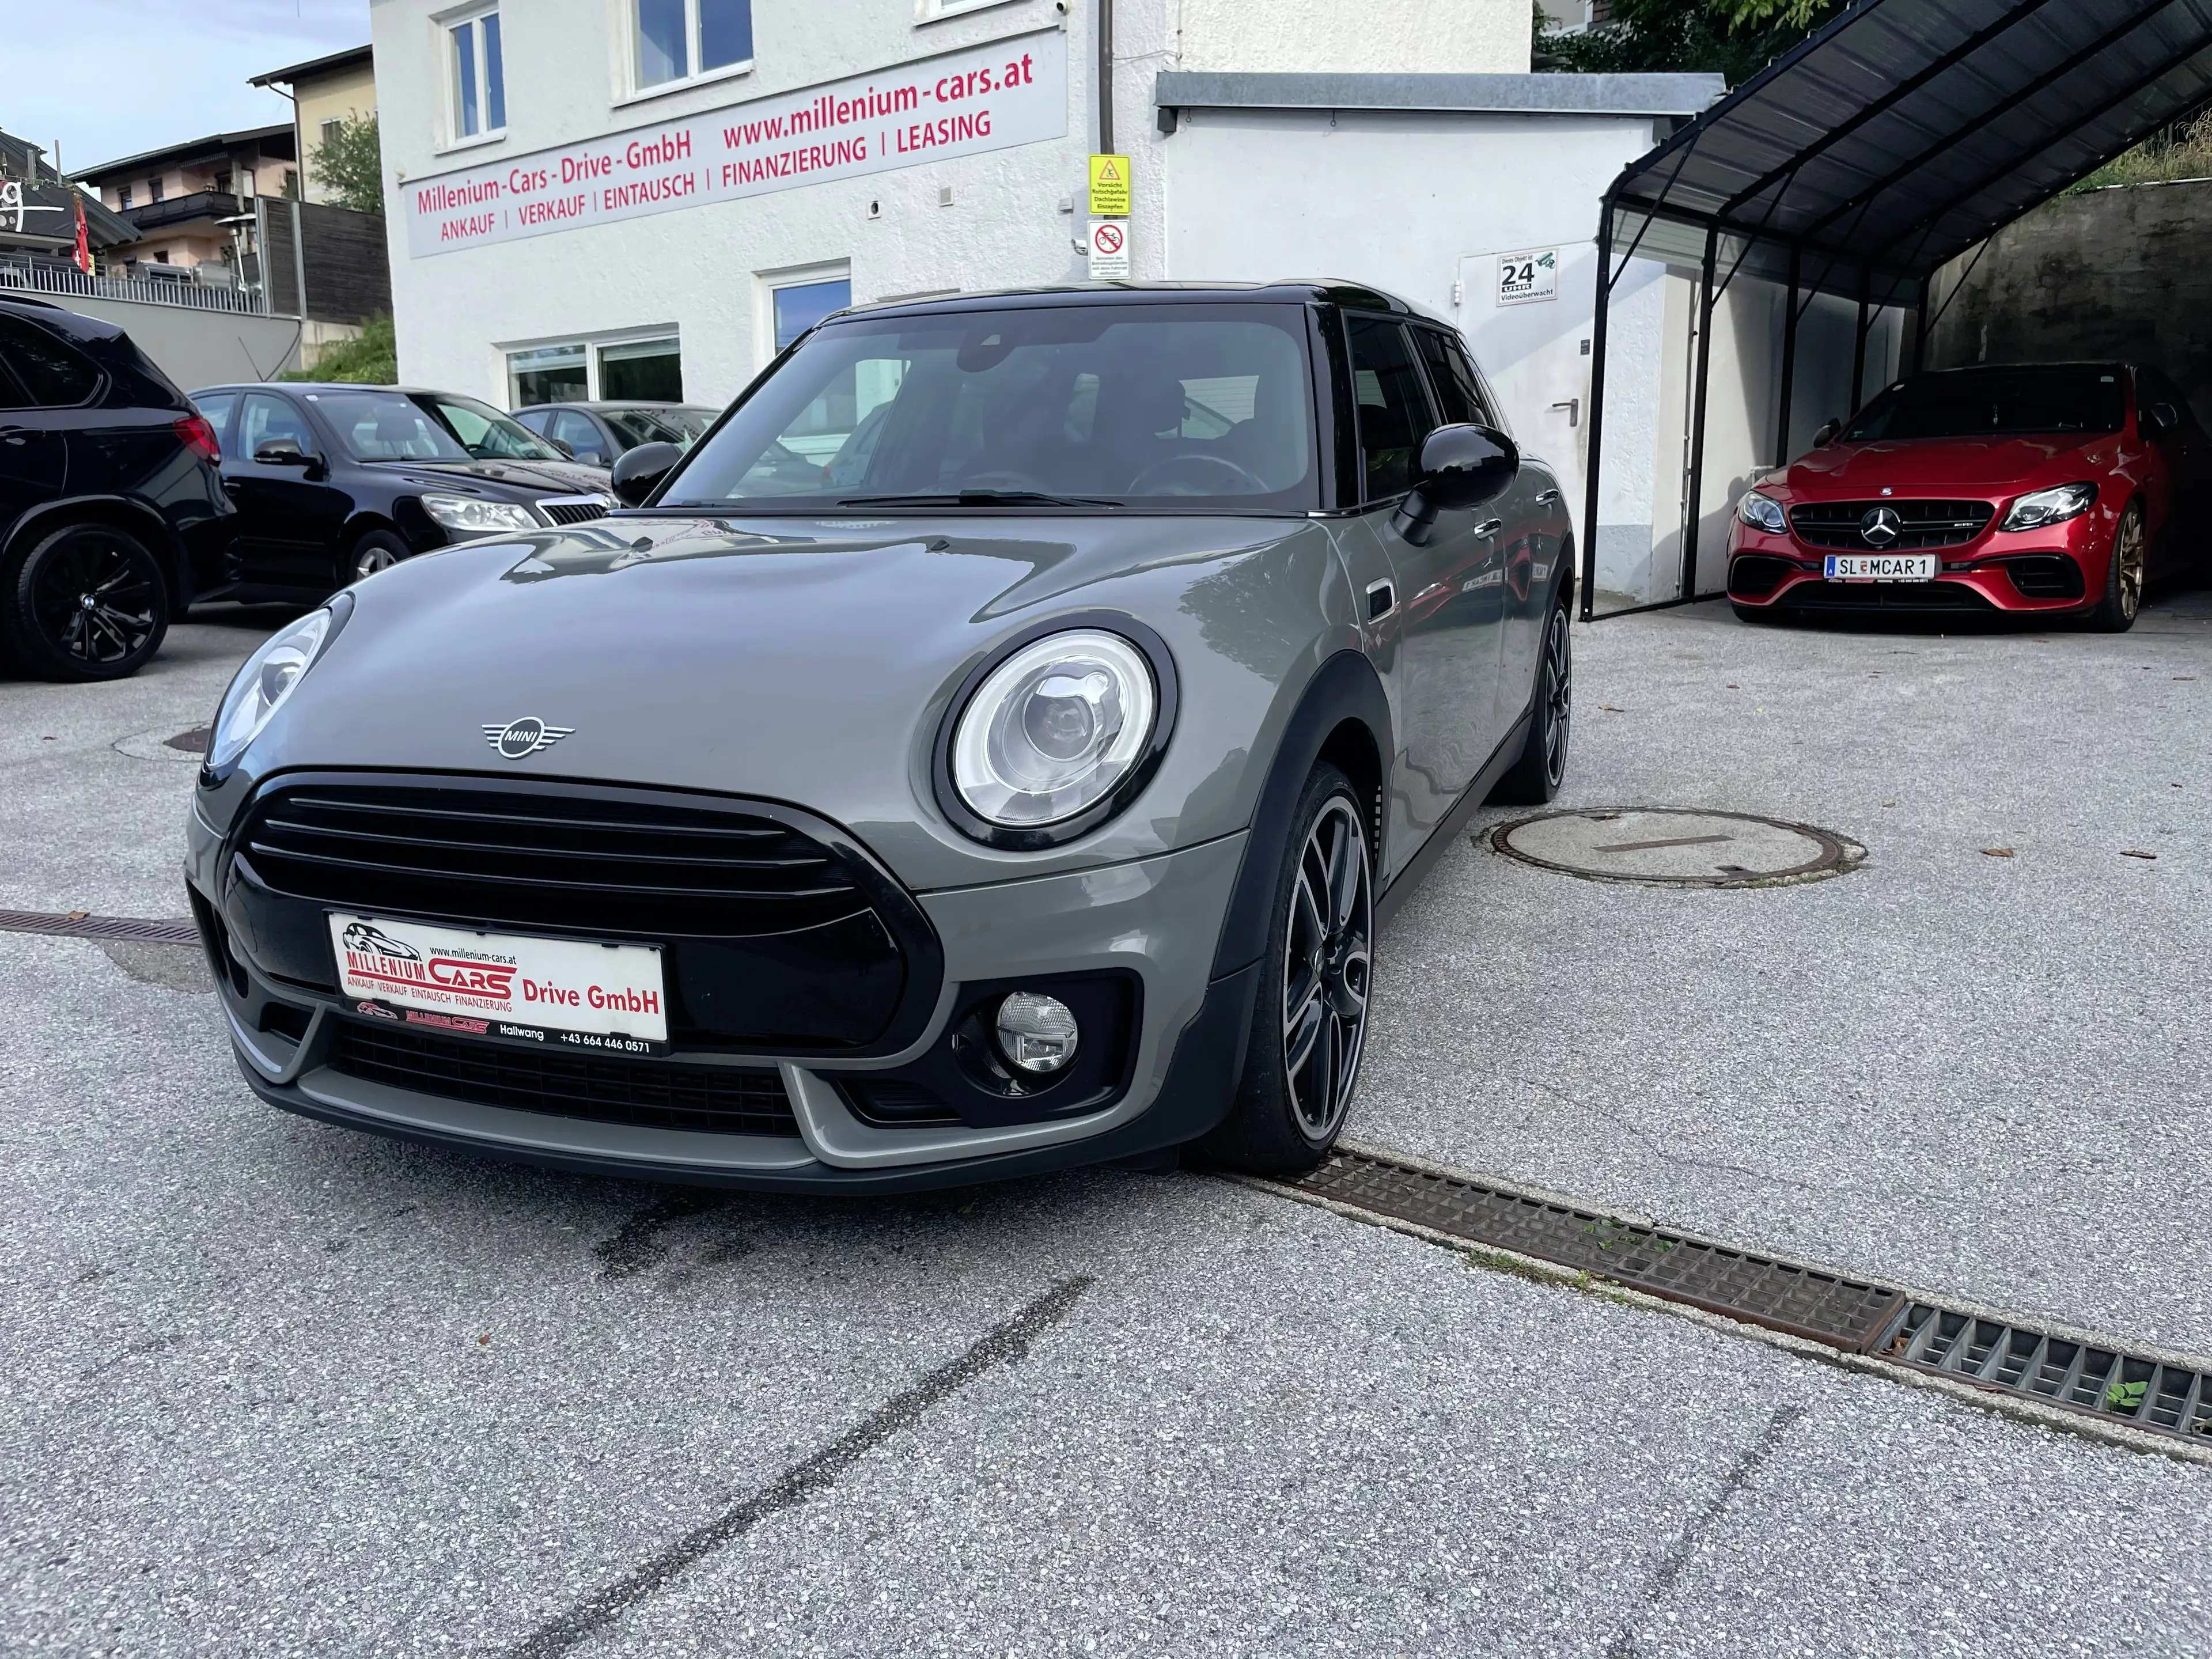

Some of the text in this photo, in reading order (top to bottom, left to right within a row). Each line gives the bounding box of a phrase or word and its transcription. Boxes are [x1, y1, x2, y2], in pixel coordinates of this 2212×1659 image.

[724, 54, 1033, 150] www.millenium-cars.at
[441, 111, 991, 241] ANKAUF VERKAUF EINTAUSCH FINANZIERUNG LEASING
[1502, 263, 1535, 286] 24
[1501, 289, 1554, 301] Videoüberwacht
[1840, 559, 1926, 575] SL MCAR 1
[504, 730, 538, 743] MINI
[429, 947, 517, 965] www.millenium-cars.at
[346, 951, 517, 999] MILLENIUM CARS
[347, 976, 512, 1013] ANKAUF VERKAUF EINTAUSCH FINANZIERUNG
[522, 978, 659, 1014] Drive GmbH
[500, 1024, 650, 1053] Hallwang +43 664 446 0571
